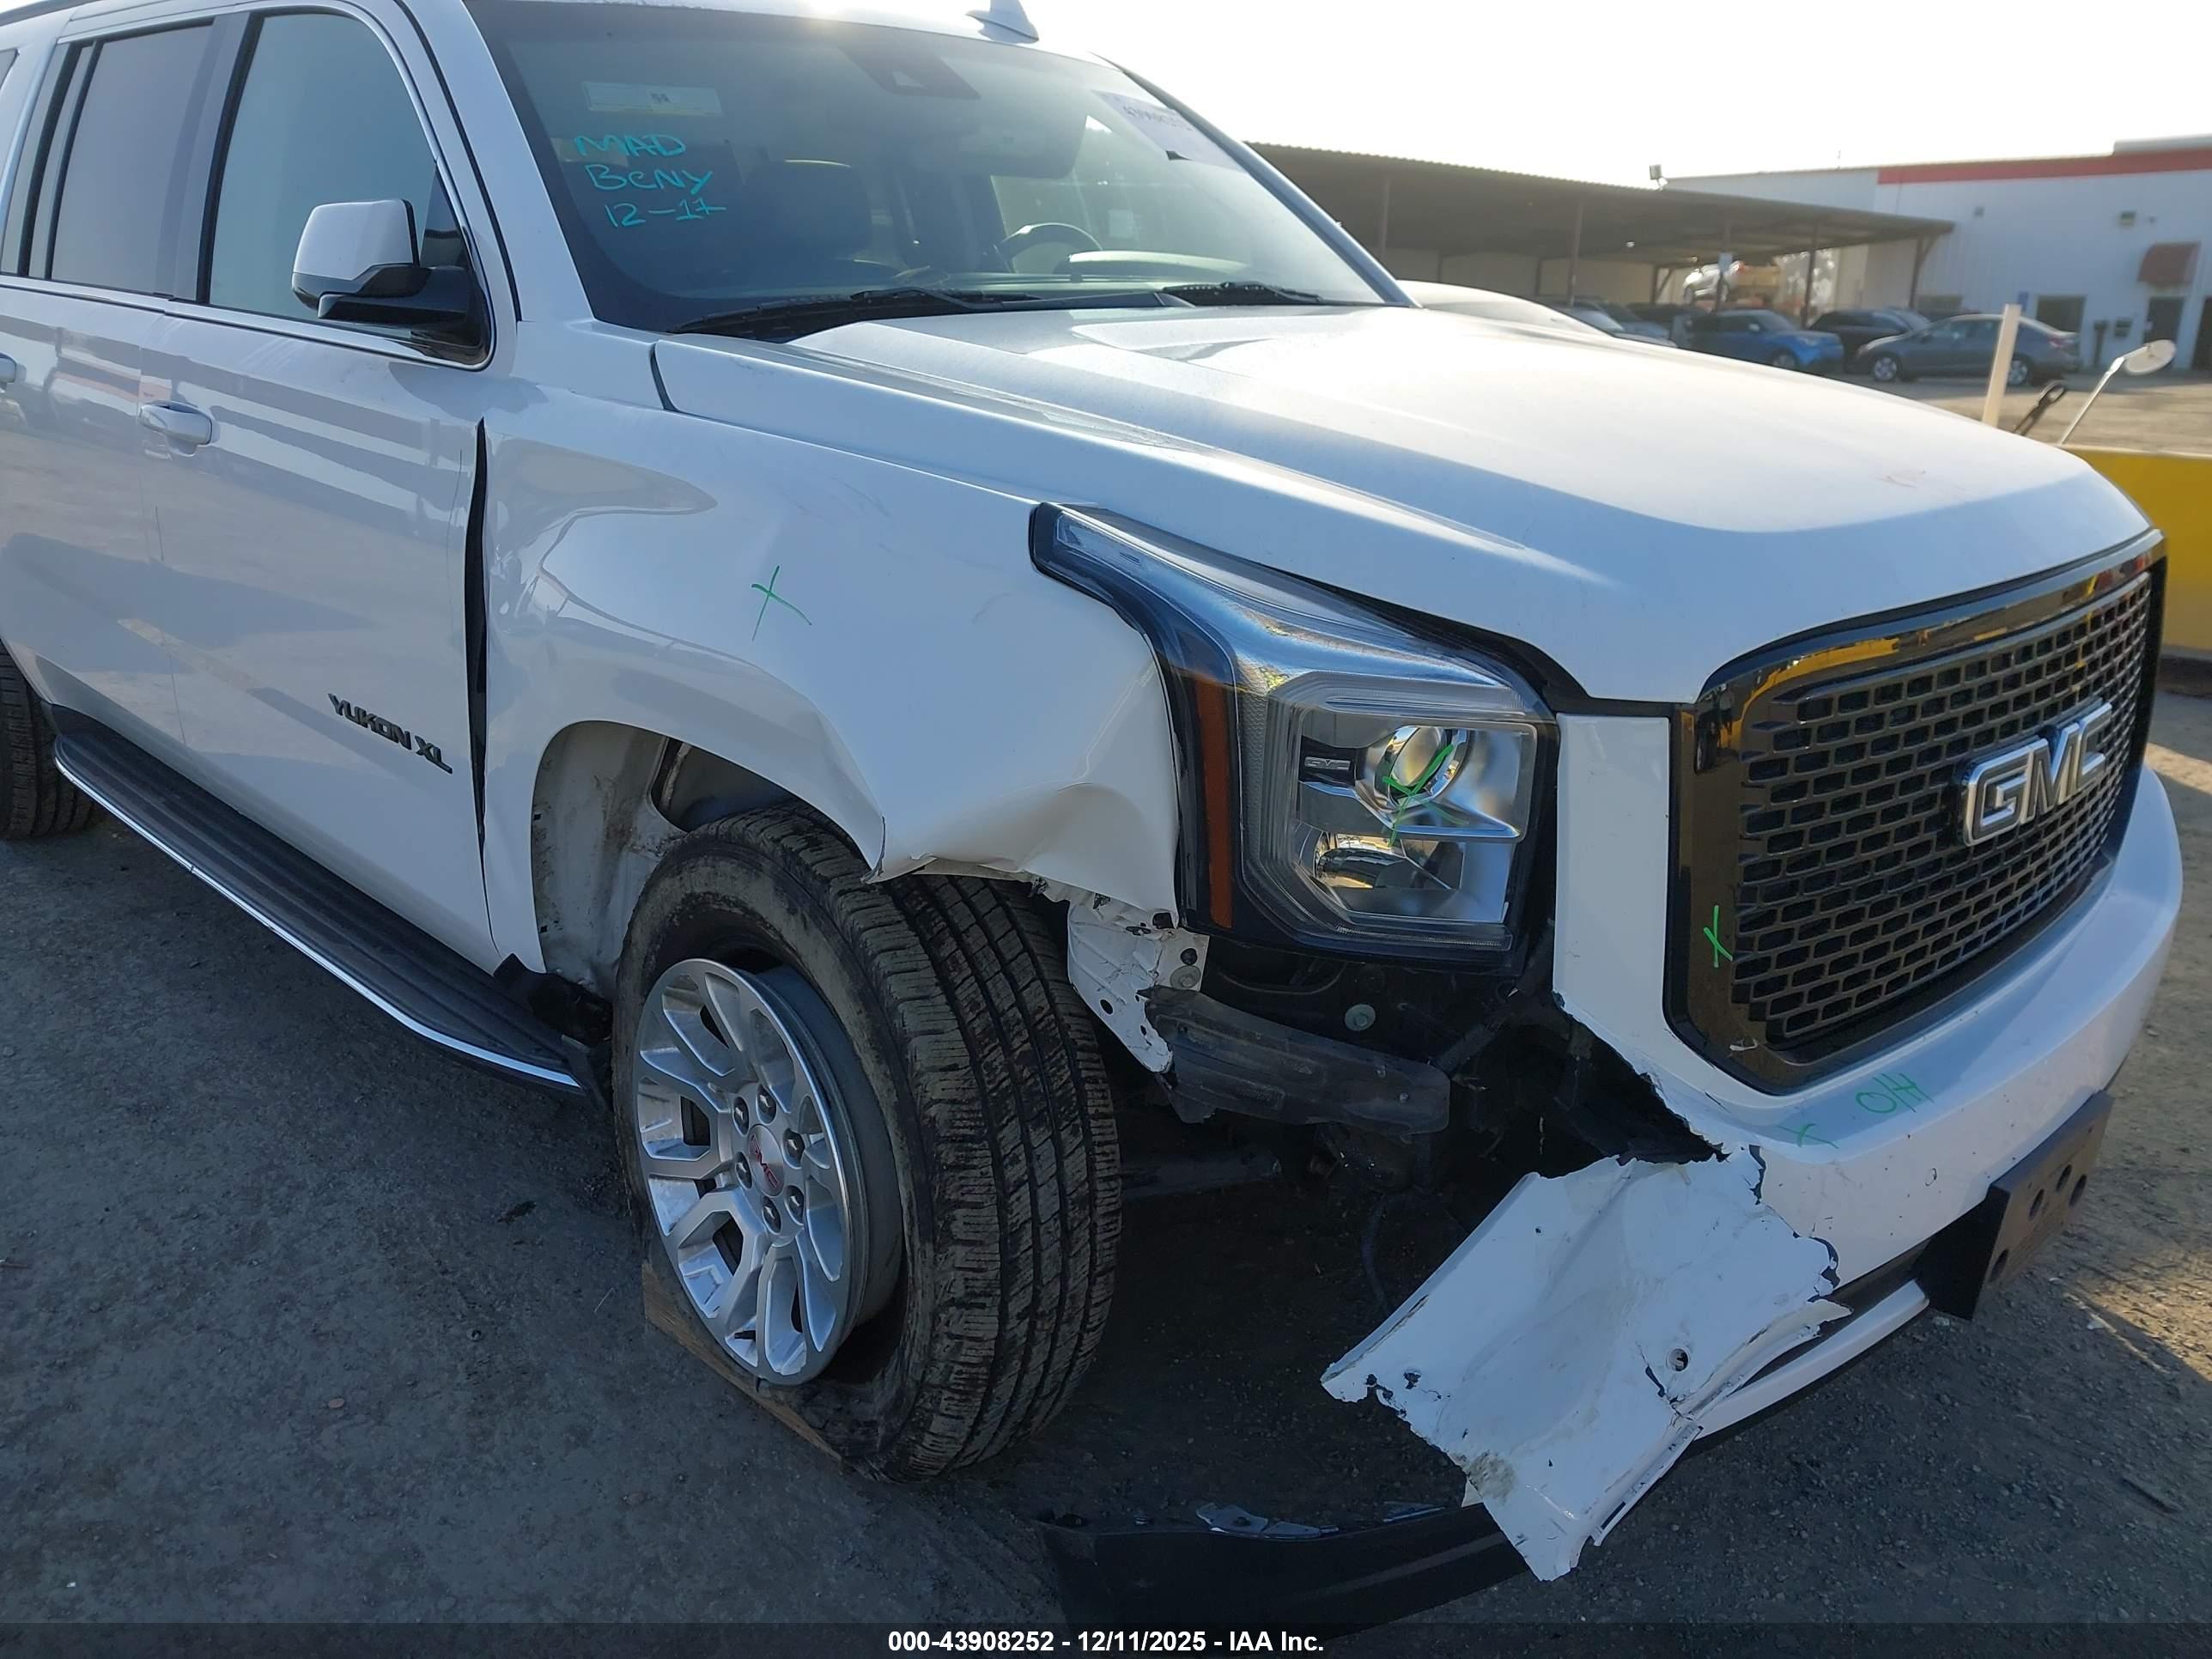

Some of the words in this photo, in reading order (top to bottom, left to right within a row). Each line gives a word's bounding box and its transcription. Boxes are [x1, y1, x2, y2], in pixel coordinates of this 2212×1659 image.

[574, 134, 686, 157] MAD
[327, 693, 412, 750] YUKON
[414, 734, 453, 775] XL
[1964, 702, 2112, 847] GMC
[749, 1133, 781, 1188] GMC
